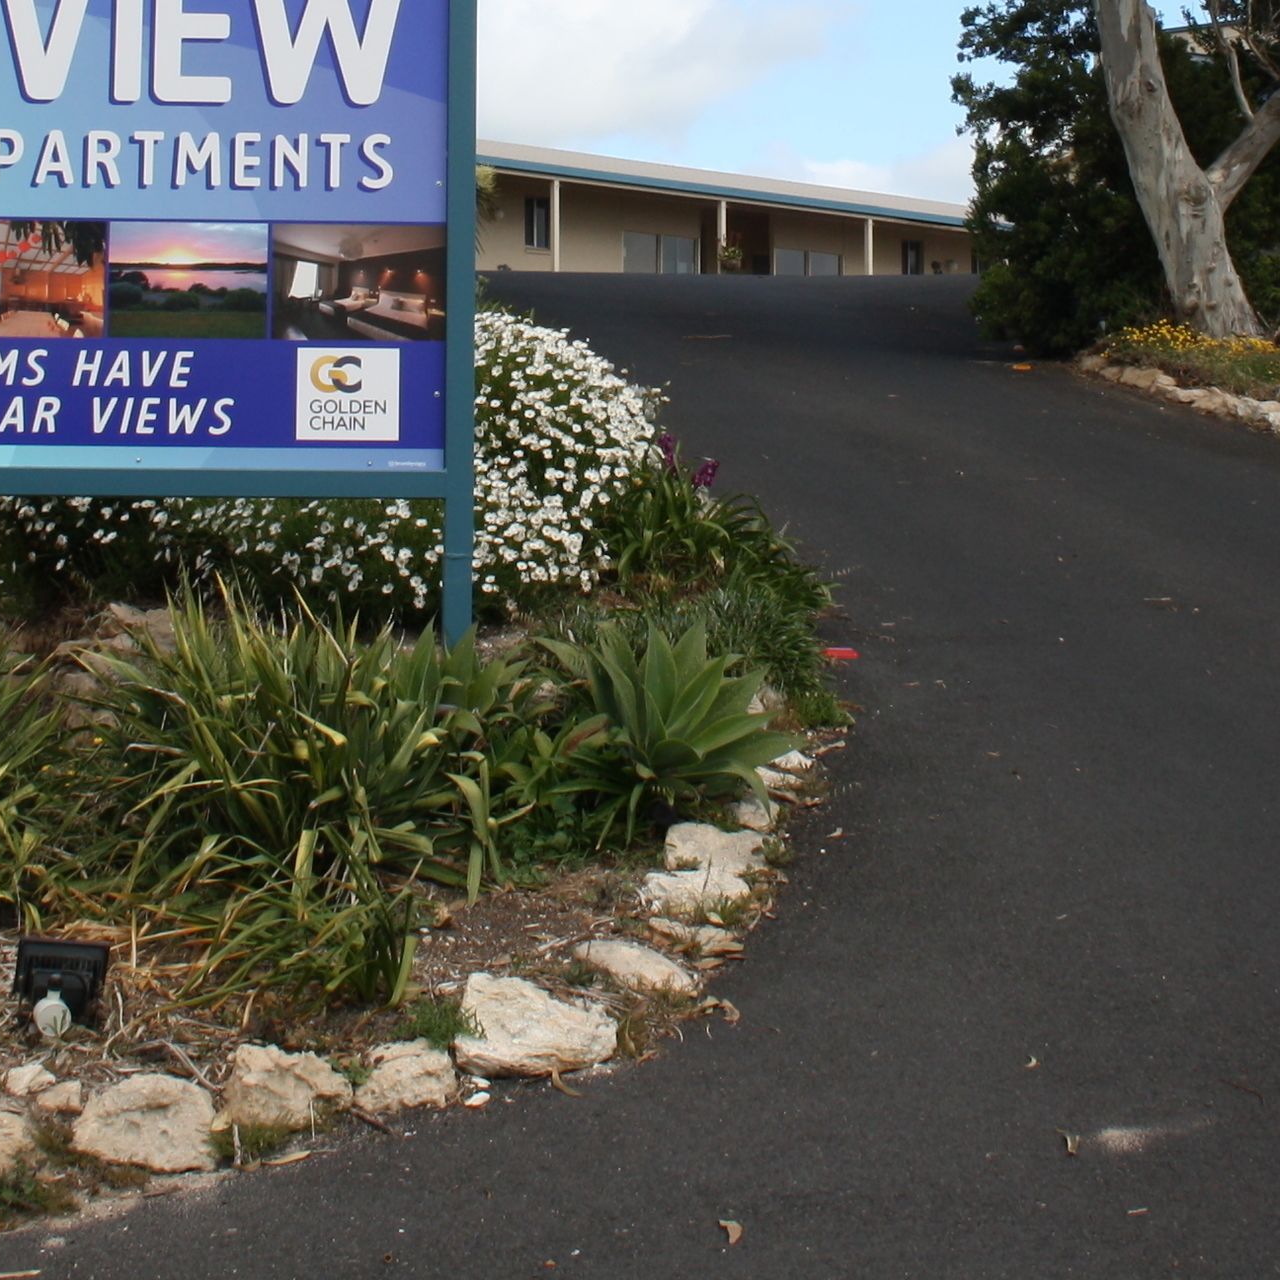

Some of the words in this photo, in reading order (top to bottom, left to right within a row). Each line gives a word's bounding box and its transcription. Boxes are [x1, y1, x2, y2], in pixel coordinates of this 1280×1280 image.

[72, 350, 195, 388] HAVE
[92, 397, 235, 436] VIEWS
[309, 399, 387, 414] GOLDEN
[309, 416, 366, 431] CHAIN
